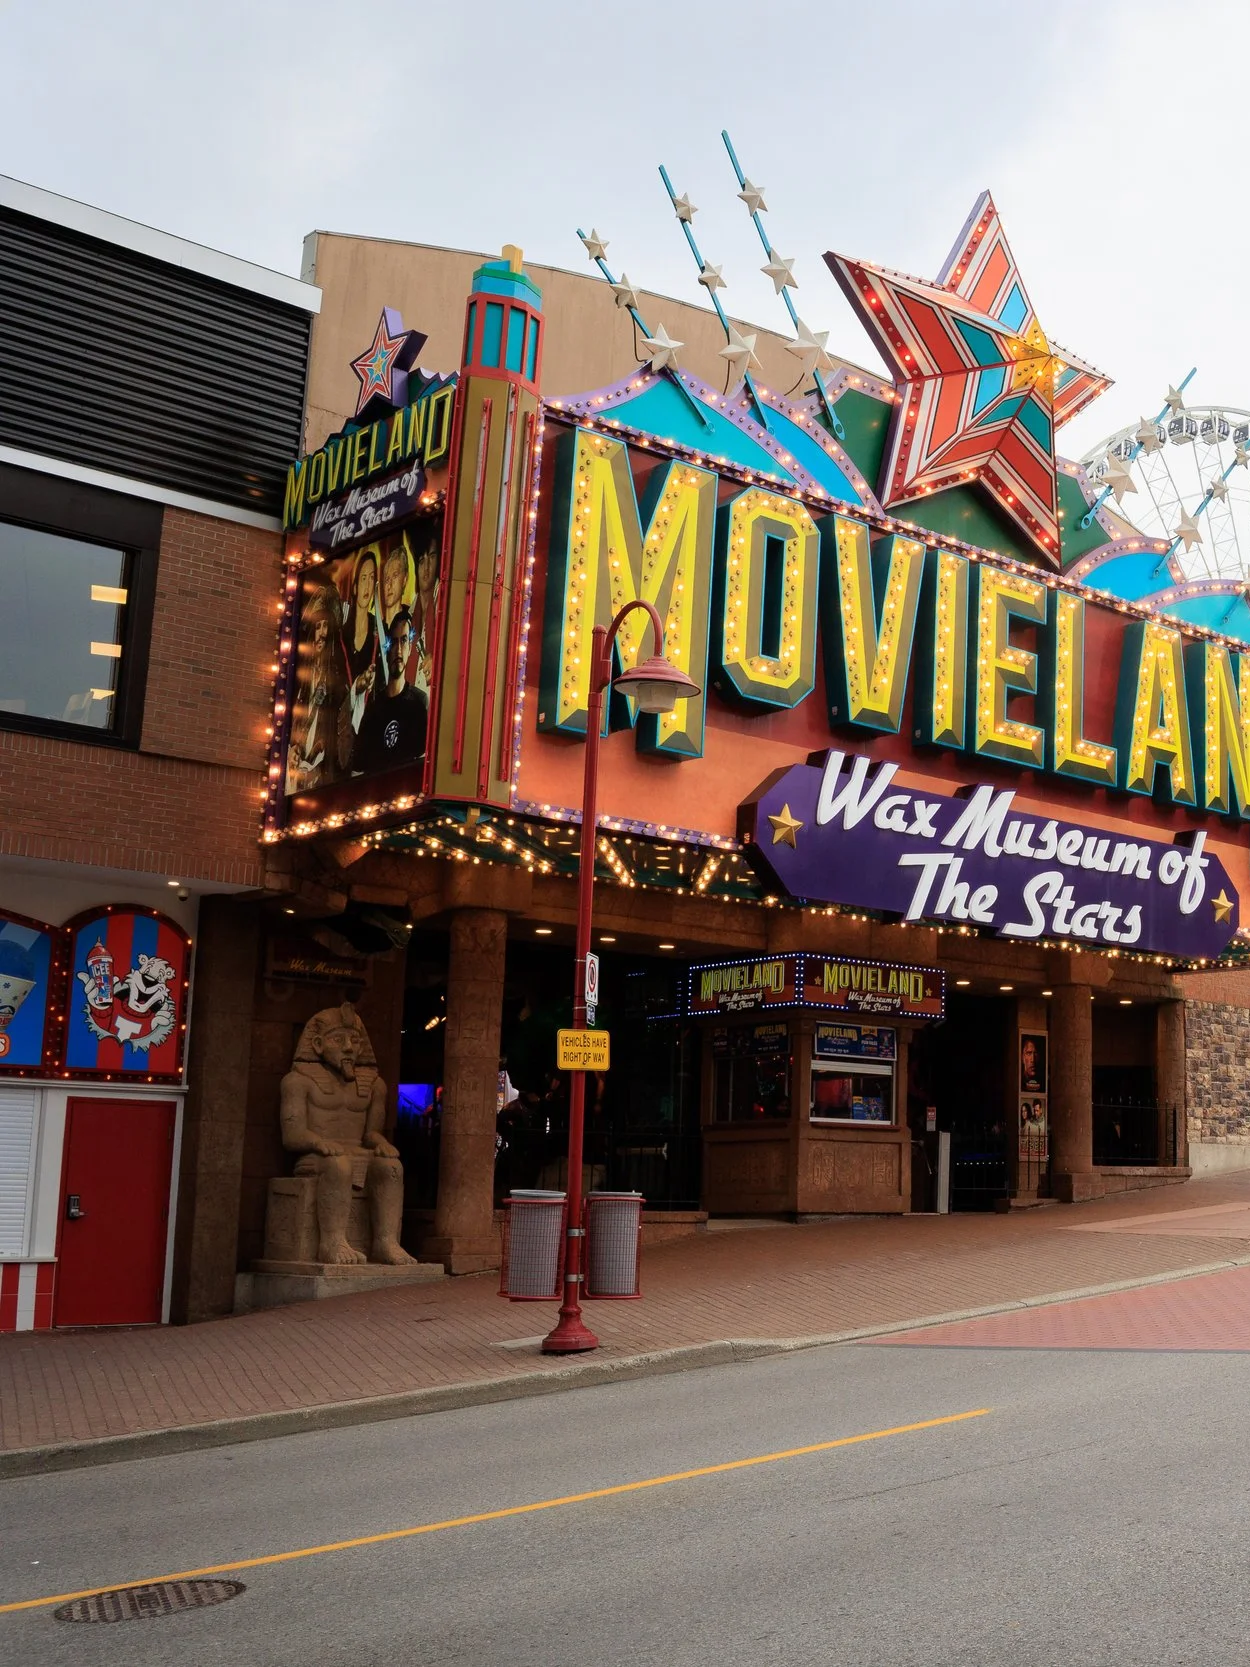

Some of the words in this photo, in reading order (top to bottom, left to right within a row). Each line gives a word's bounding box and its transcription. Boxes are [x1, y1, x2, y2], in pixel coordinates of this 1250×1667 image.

[283, 384, 455, 531] MOVIELAND
[312, 500, 340, 532] Wax
[341, 480, 399, 517] Museum
[401, 459, 419, 496] of
[330, 521, 354, 547] The
[354, 502, 395, 538] Stars
[816, 749, 941, 838] Wax
[942, 783, 1153, 880] Museum
[1159, 830, 1209, 915] of
[898, 852, 996, 923] The
[1002, 871, 1142, 945] Stars
[92, 964, 110, 976] ICEE
[701, 961, 784, 1002] MOVIELAND
[823, 962, 923, 1004] MOVIELAND
[719, 993, 731, 1004] Wax
[726, 1002, 737, 1011] The
[848, 991, 863, 1001] Wax
[863, 993, 893, 1004] Museum
[893, 996, 901, 1007] of
[858, 1002, 871, 1011] The
[871, 1002, 892, 1012] Stars
[561, 1035, 591, 1048] VEHICLES
[592, 1038, 606, 1048] HAVE
[563, 1051, 581, 1062] RIGHT
[583, 1052, 591, 1062] OF
[593, 1053, 605, 1063] WAY
